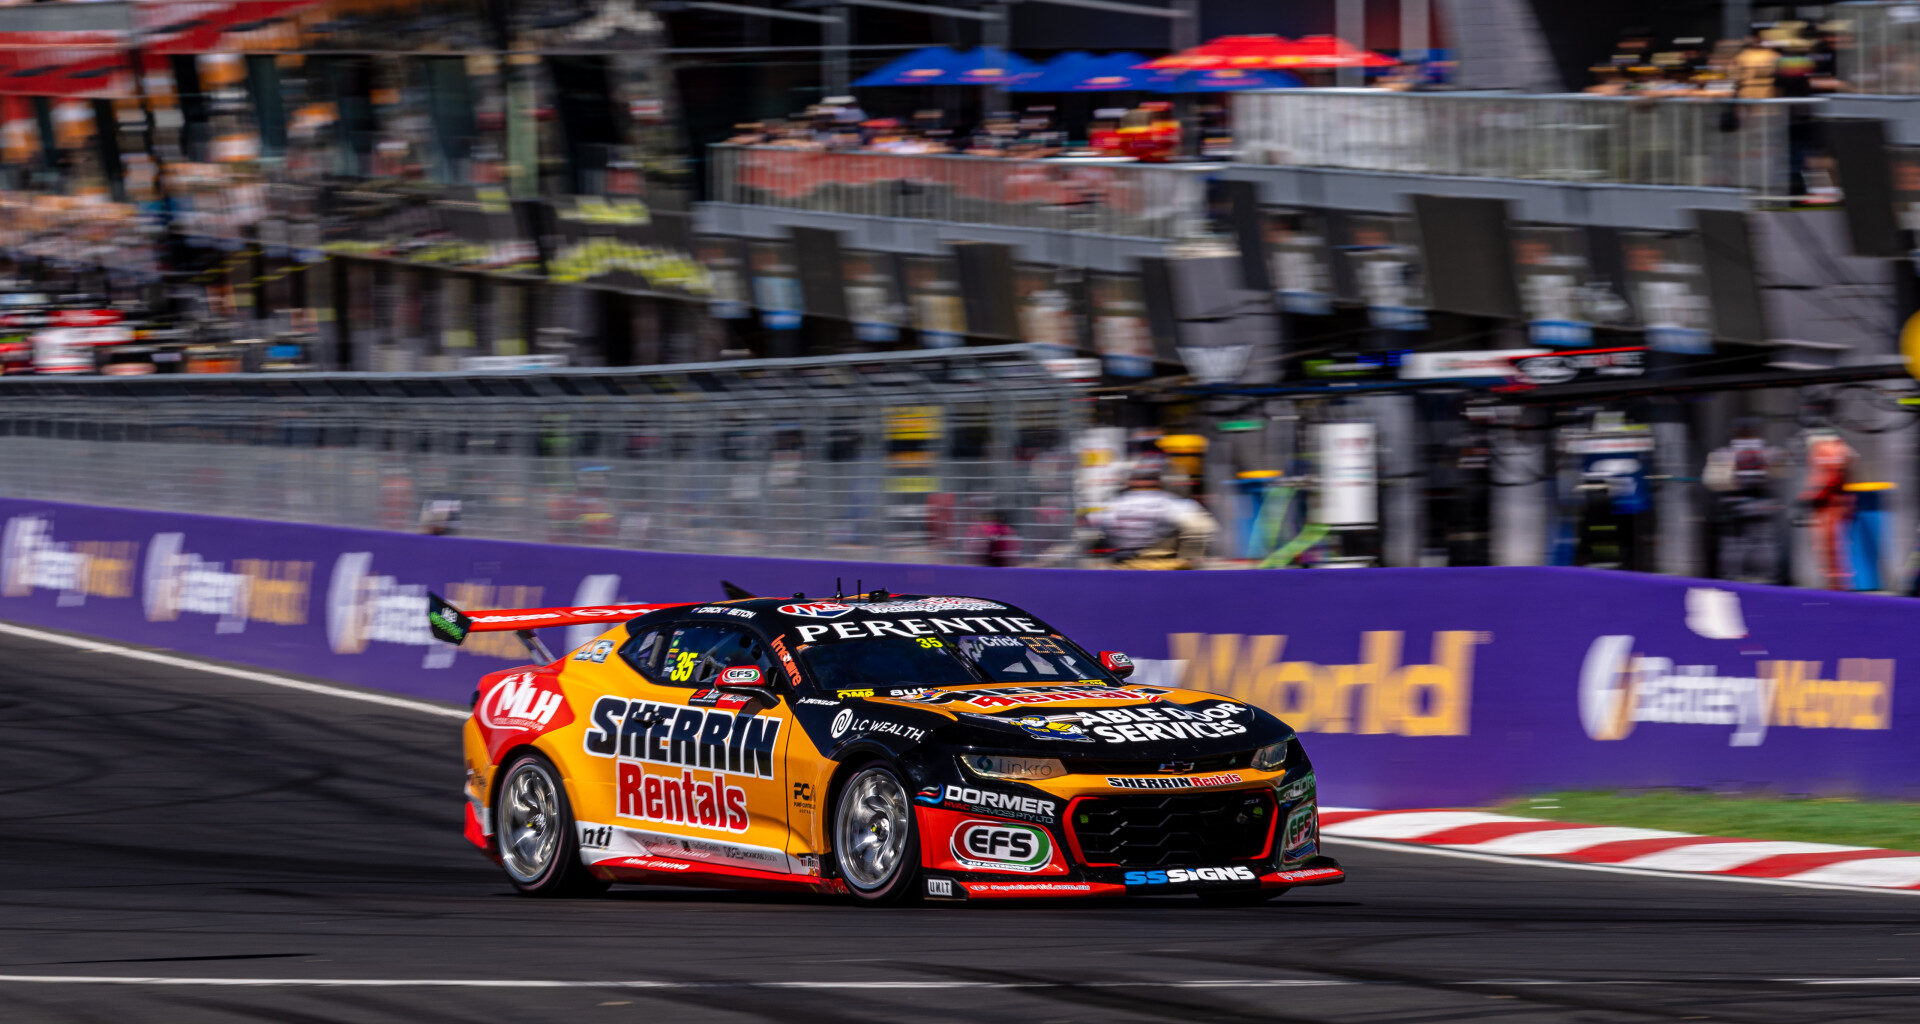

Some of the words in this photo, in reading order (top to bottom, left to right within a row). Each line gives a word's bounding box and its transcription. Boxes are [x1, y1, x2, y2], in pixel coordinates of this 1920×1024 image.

[795, 617, 1045, 643] PERENTIE
[979, 636, 1024, 647] Crick
[916, 637, 943, 649] 35
[670, 651, 698, 682] 35
[729, 669, 754, 679] EFS
[494, 681, 564, 725] MLH
[1076, 706, 1170, 727] ABLE
[1171, 702, 1247, 723] DOOR
[584, 695, 782, 779] SHERRIN
[851, 718, 870, 731] LC
[869, 720, 926, 742] WEALTH
[1092, 719, 1248, 744] SERVICES
[999, 759, 1053, 776] Linkro
[616, 760, 749, 834] Rentals
[945, 785, 1056, 817] DORMER
[944, 801, 970, 811] HVAC
[971, 805, 1016, 818] SERVICES
[1016, 811, 1035, 821] PTY
[582, 826, 613, 847] nti
[969, 828, 1033, 858] EFS
[929, 880, 951, 896] UNIT
